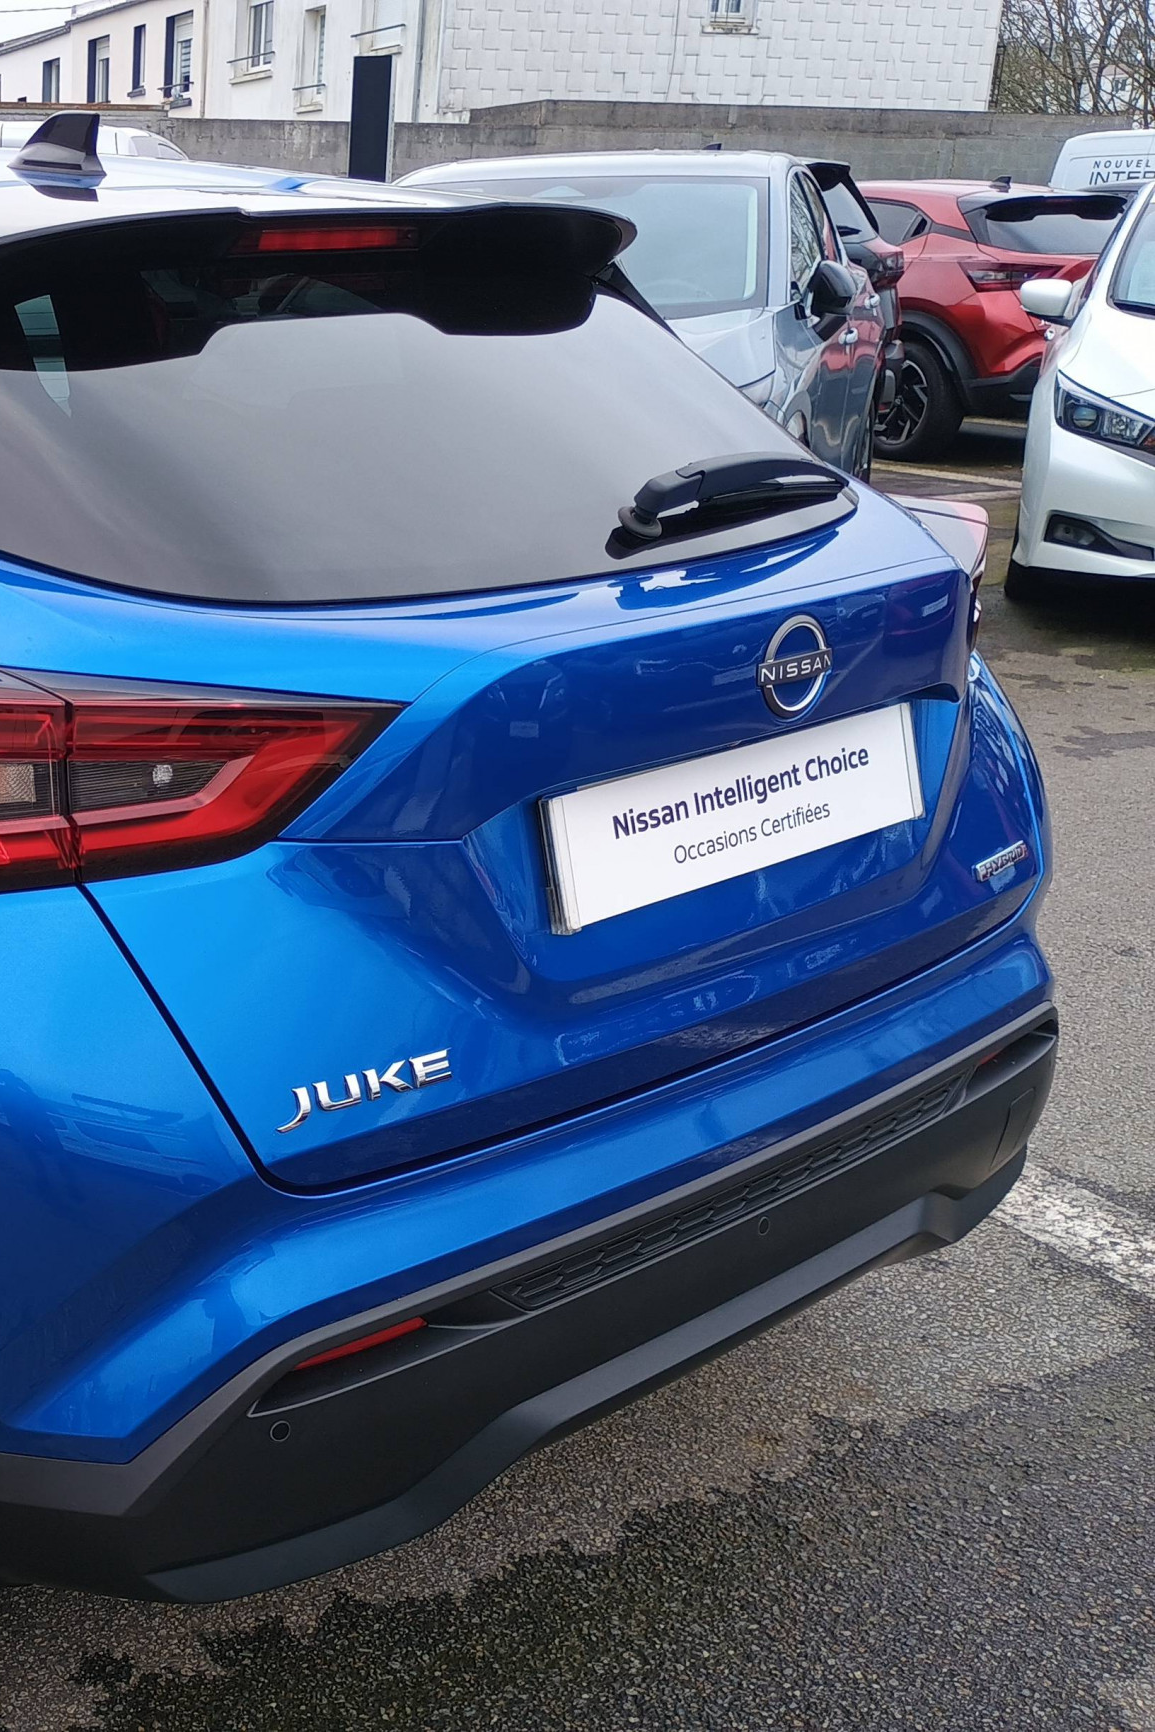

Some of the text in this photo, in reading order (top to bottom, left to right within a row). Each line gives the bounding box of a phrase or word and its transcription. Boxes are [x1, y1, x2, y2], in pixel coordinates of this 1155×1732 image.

[760, 654, 832, 683] NISSAN
[612, 746, 870, 840] Nissan Intelligent Choice
[674, 800, 831, 864] Occasions Certifiées
[275, 1047, 453, 1134] JUKE
